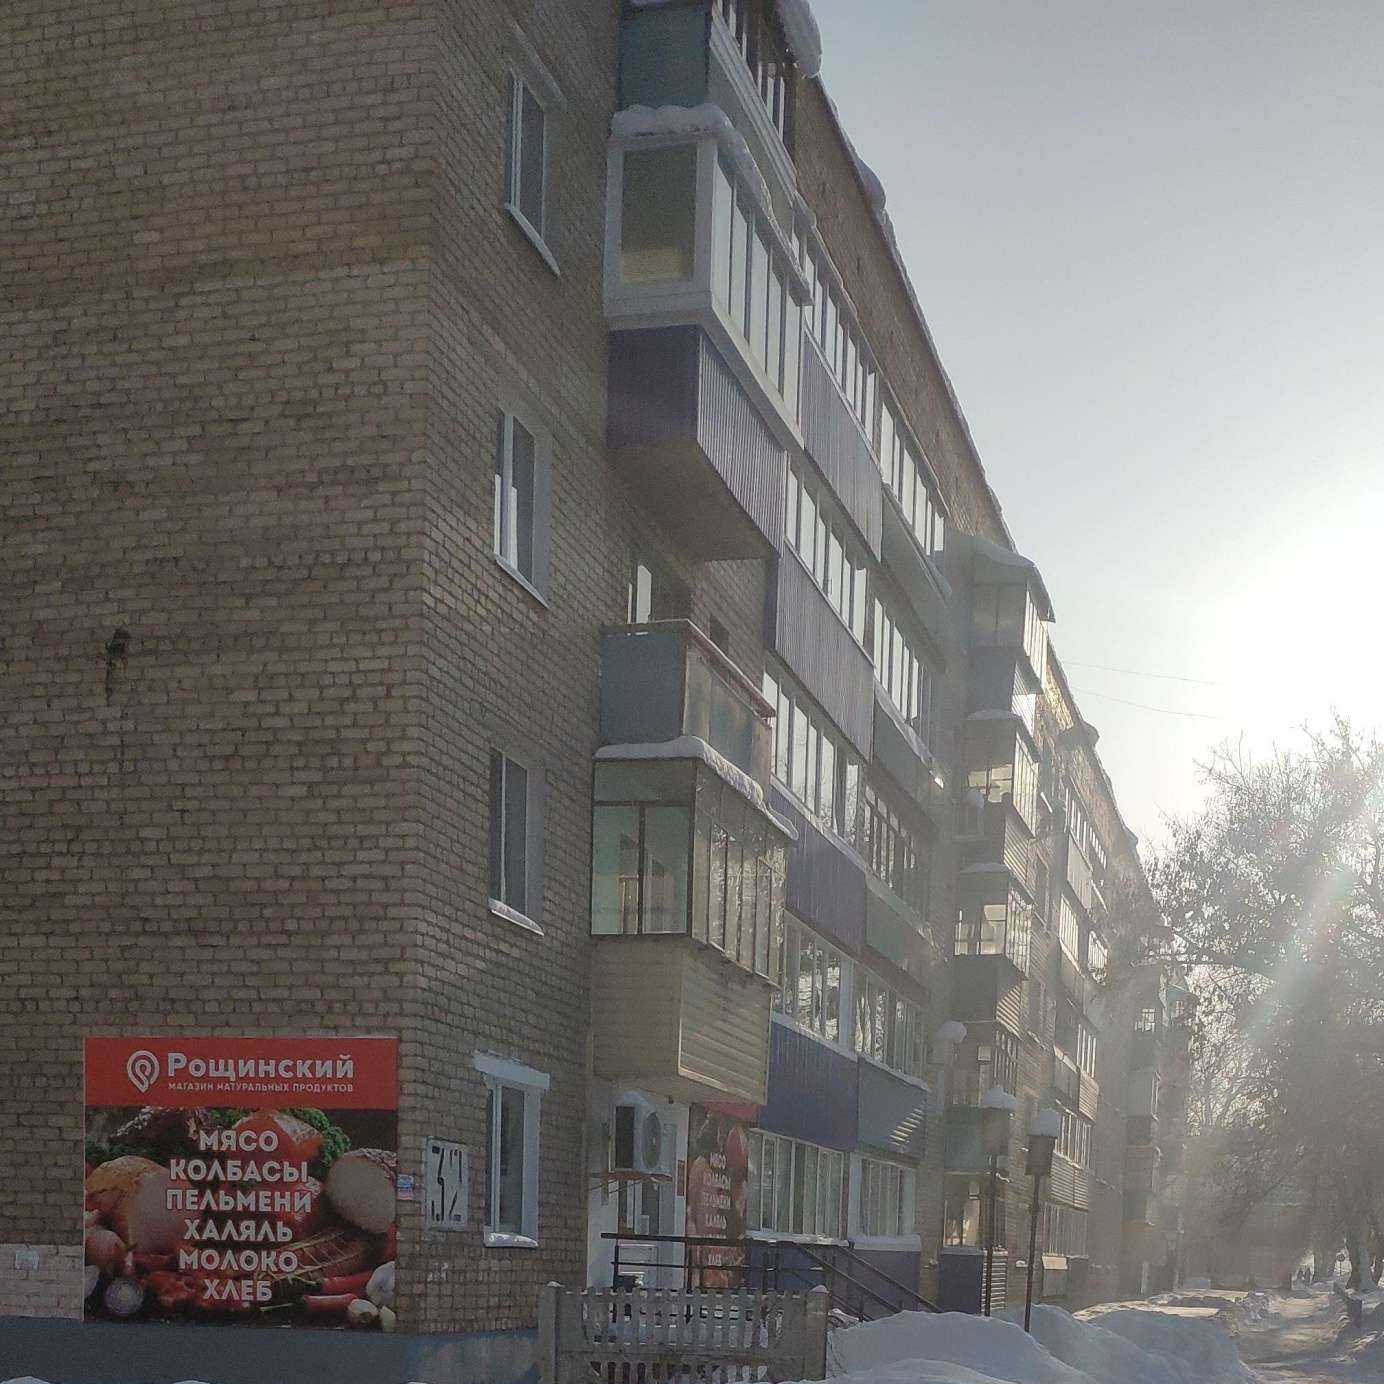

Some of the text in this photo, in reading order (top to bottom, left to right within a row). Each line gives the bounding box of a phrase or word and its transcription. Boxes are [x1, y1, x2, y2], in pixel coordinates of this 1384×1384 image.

[167, 1052, 354, 1081] Рощинский
[168, 1082, 353, 1093] МАГАЗИН НАТУРАЛЬНЫХ ПРОДУКТОВ
[199, 1130, 279, 1152] МЯСО
[170, 1160, 308, 1183] КОЛБАСЫ
[166, 1189, 312, 1213] ПЕЛЬМЕНИ
[184, 1219, 293, 1242] ХАЛЯЛЬ
[178, 1249, 298, 1272] МОЛОКО
[203, 1279, 272, 1301] ХЛЕБ
